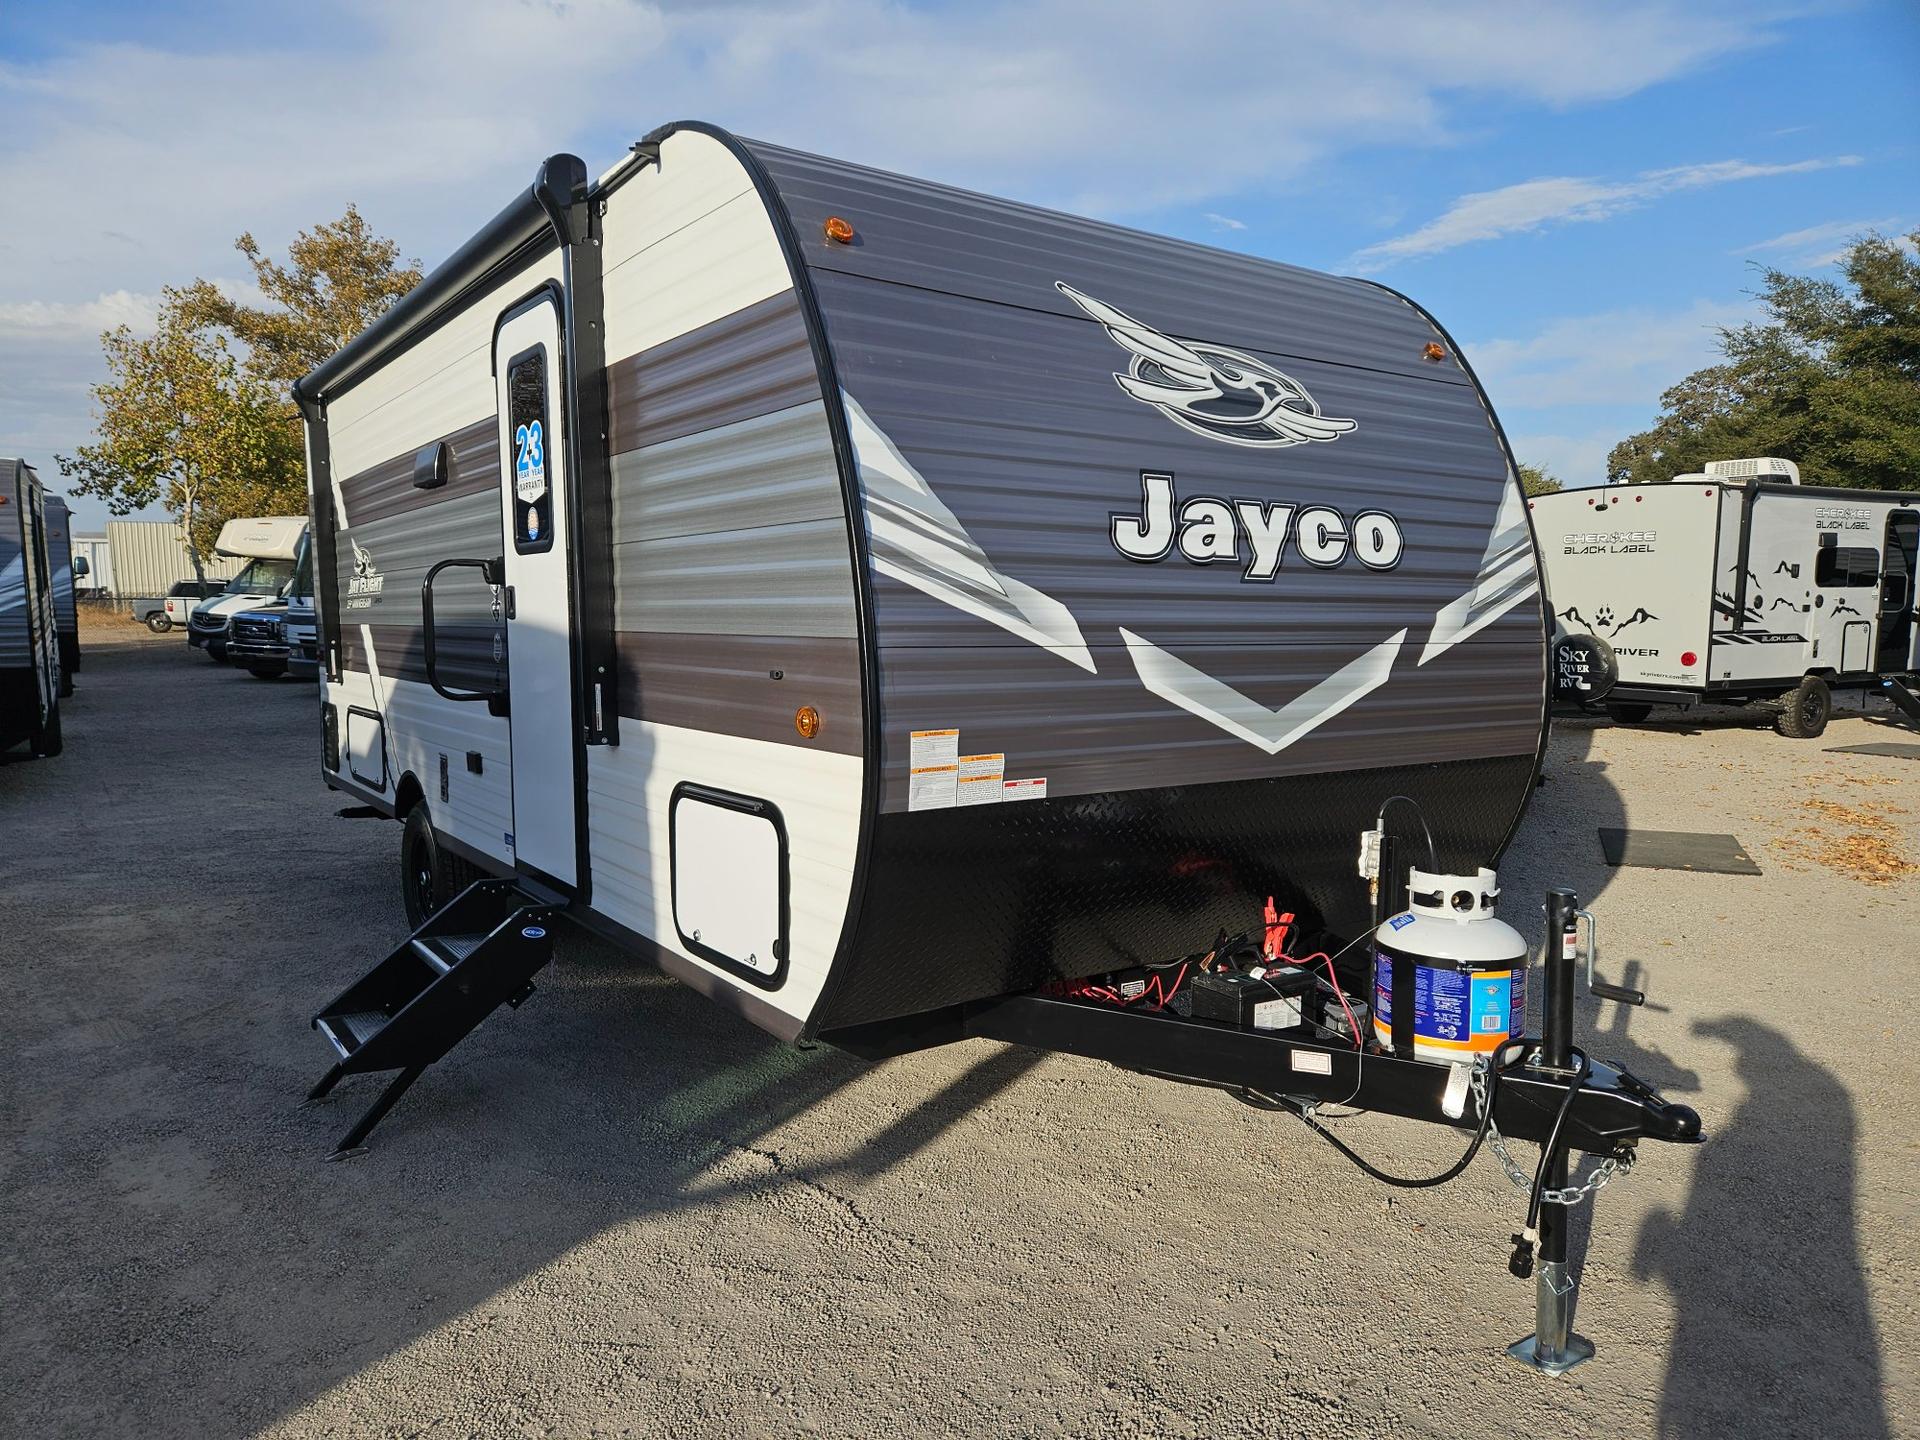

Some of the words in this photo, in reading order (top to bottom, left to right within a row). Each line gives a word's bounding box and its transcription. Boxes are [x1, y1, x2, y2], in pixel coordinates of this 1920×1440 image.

[1815, 507, 1871, 519] CHEROKEE
[1109, 469, 1404, 584] Jayco
[1816, 520, 1843, 529] BLACK
[1845, 521, 1870, 530] LABEL
[1563, 531, 1656, 544] CHEROKEE
[1564, 546, 1606, 555] BLACK
[1610, 544, 1655, 554] LABEL
[1560, 646, 1590, 662] SKY
[1612, 647, 1660, 657] RIVER
[1560, 663, 1590, 673] RIVER
[1560, 678, 1574, 689] RV
